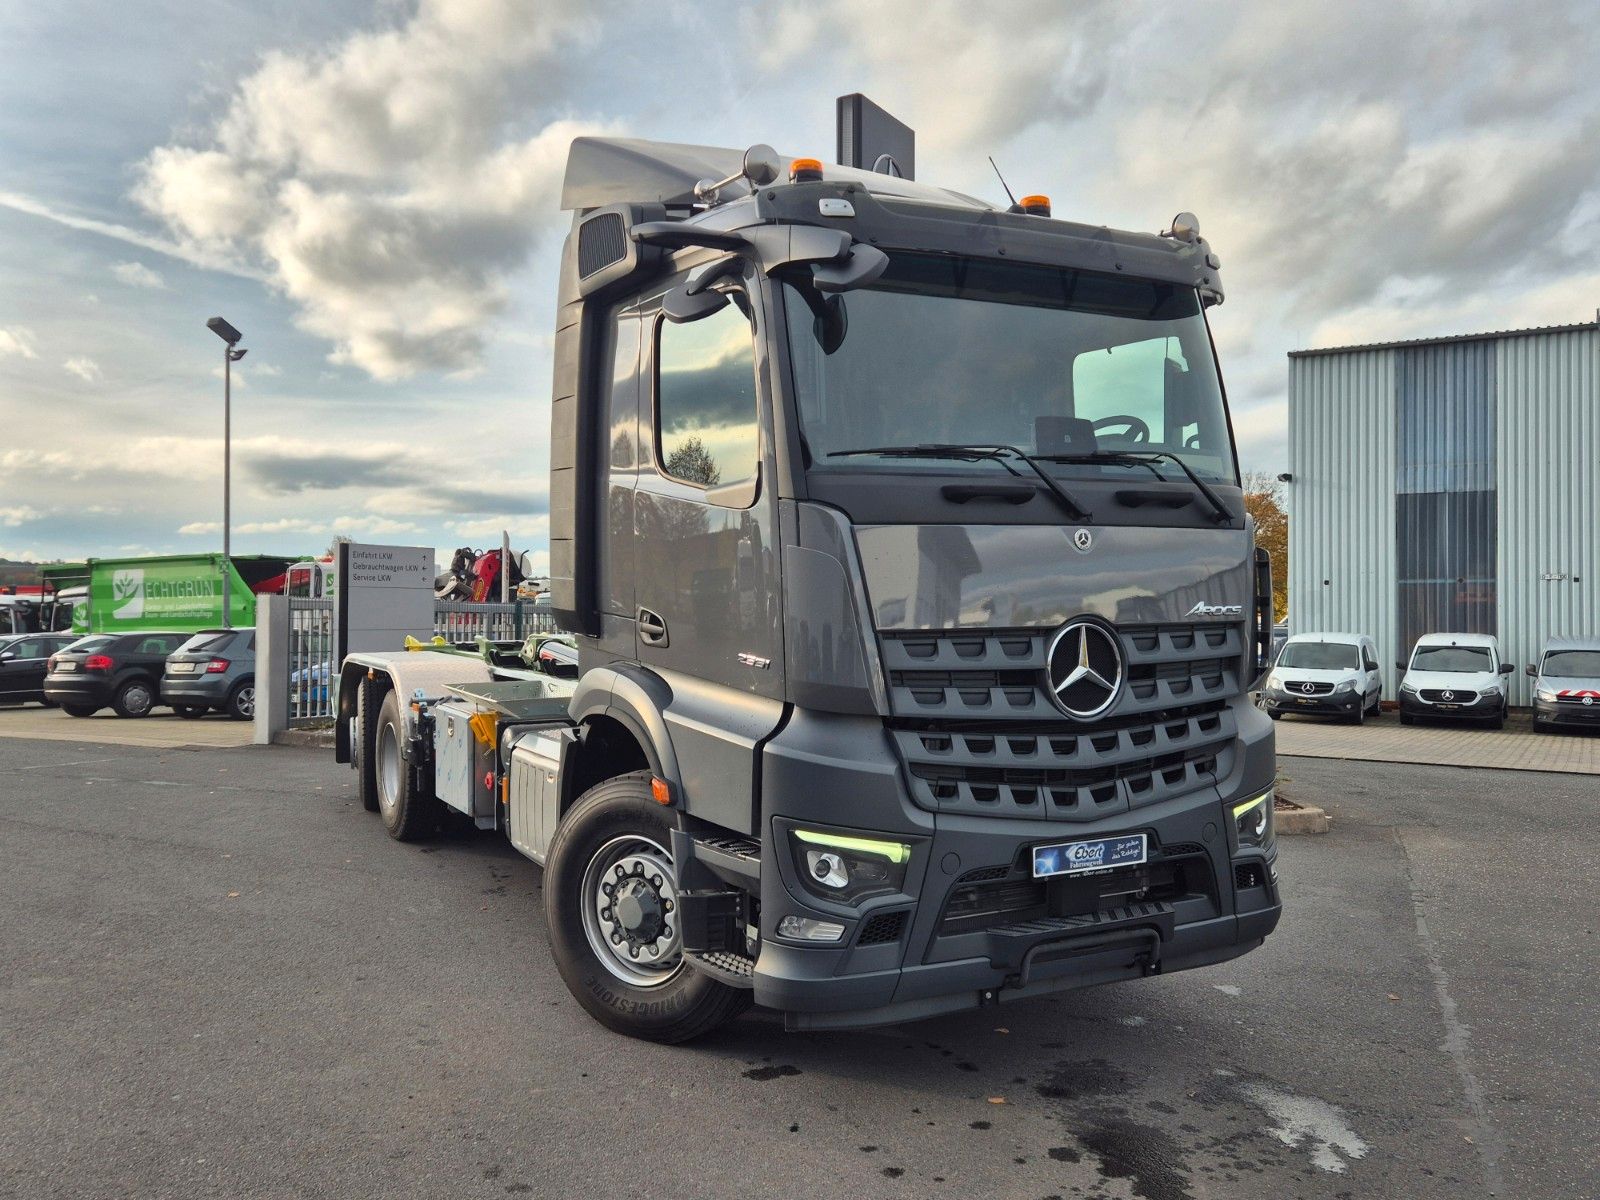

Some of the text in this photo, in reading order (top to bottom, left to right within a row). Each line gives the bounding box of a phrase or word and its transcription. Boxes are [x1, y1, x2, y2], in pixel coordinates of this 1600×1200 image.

[352, 551, 393, 560] Einfahrt LKW
[352, 562, 404, 572] Gebrauchtwagen
[352, 573, 392, 582] Service LKW
[1074, 844, 1104, 861] Ebert
